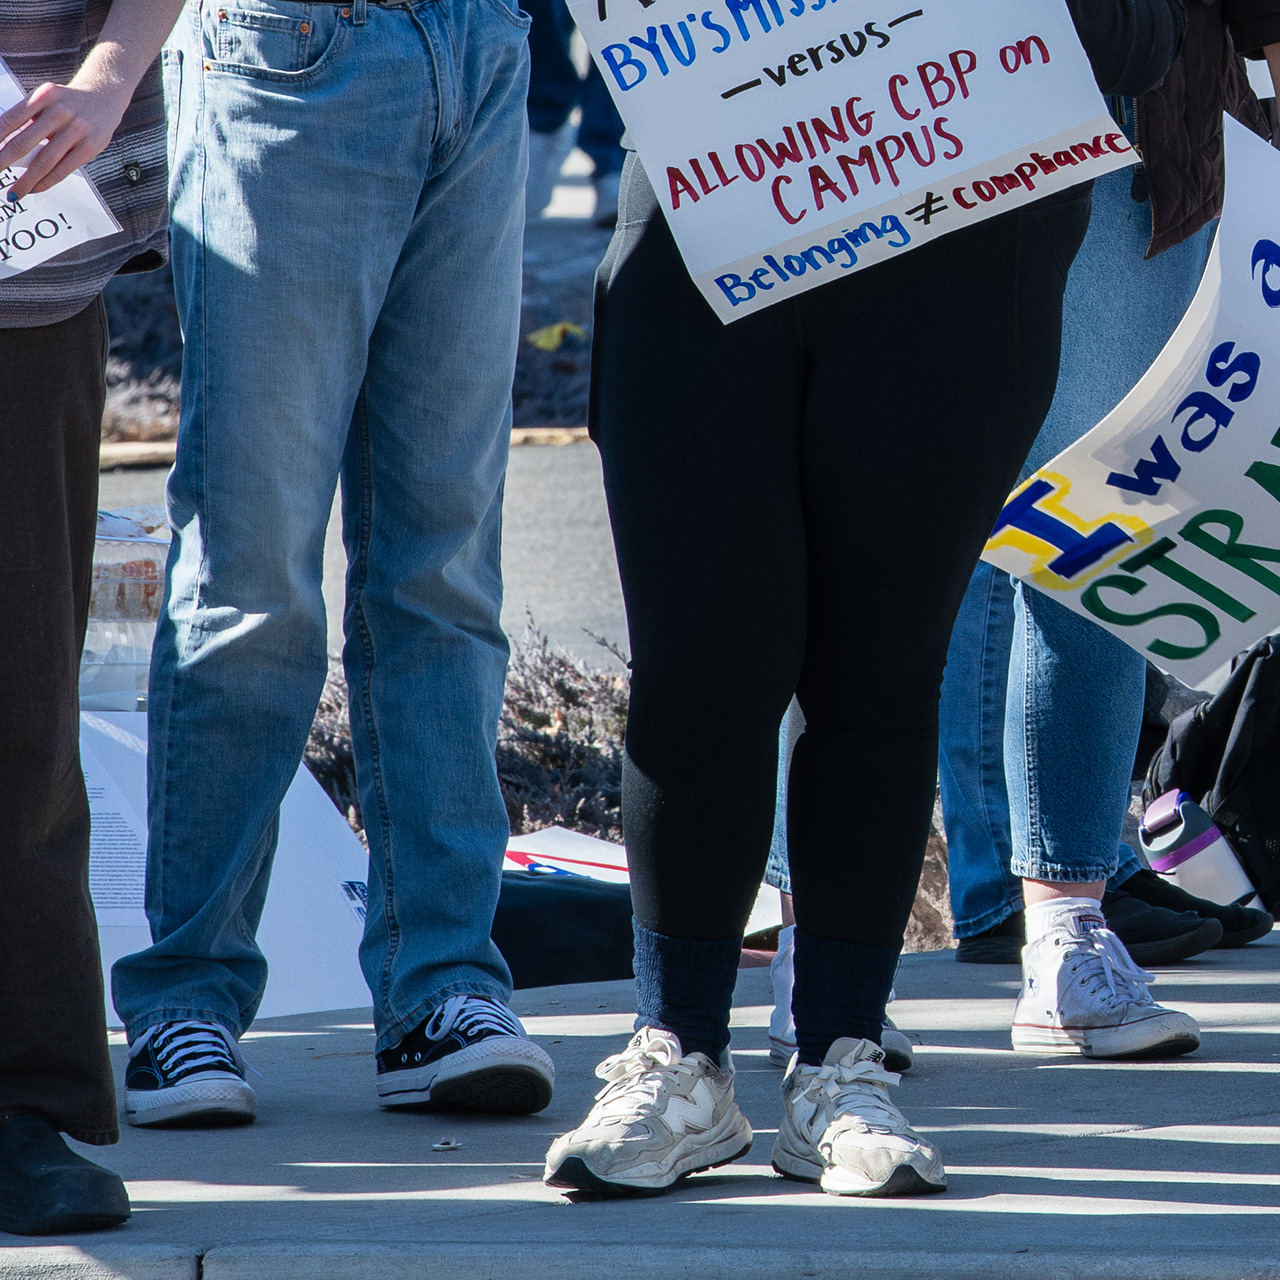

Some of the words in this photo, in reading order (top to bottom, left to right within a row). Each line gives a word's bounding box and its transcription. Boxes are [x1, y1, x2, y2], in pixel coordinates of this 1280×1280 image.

[602, 10, 731, 91] BYU'S
[665, 96, 874, 210] ALLOWING
[888, 49, 977, 121] CBP
[999, 34, 1050, 75] on
[770, 117, 964, 225] CAMPUS
[714, 212, 910, 306] Belonging
[987, 475, 1142, 583] I
[1106, 340, 1260, 496] was
